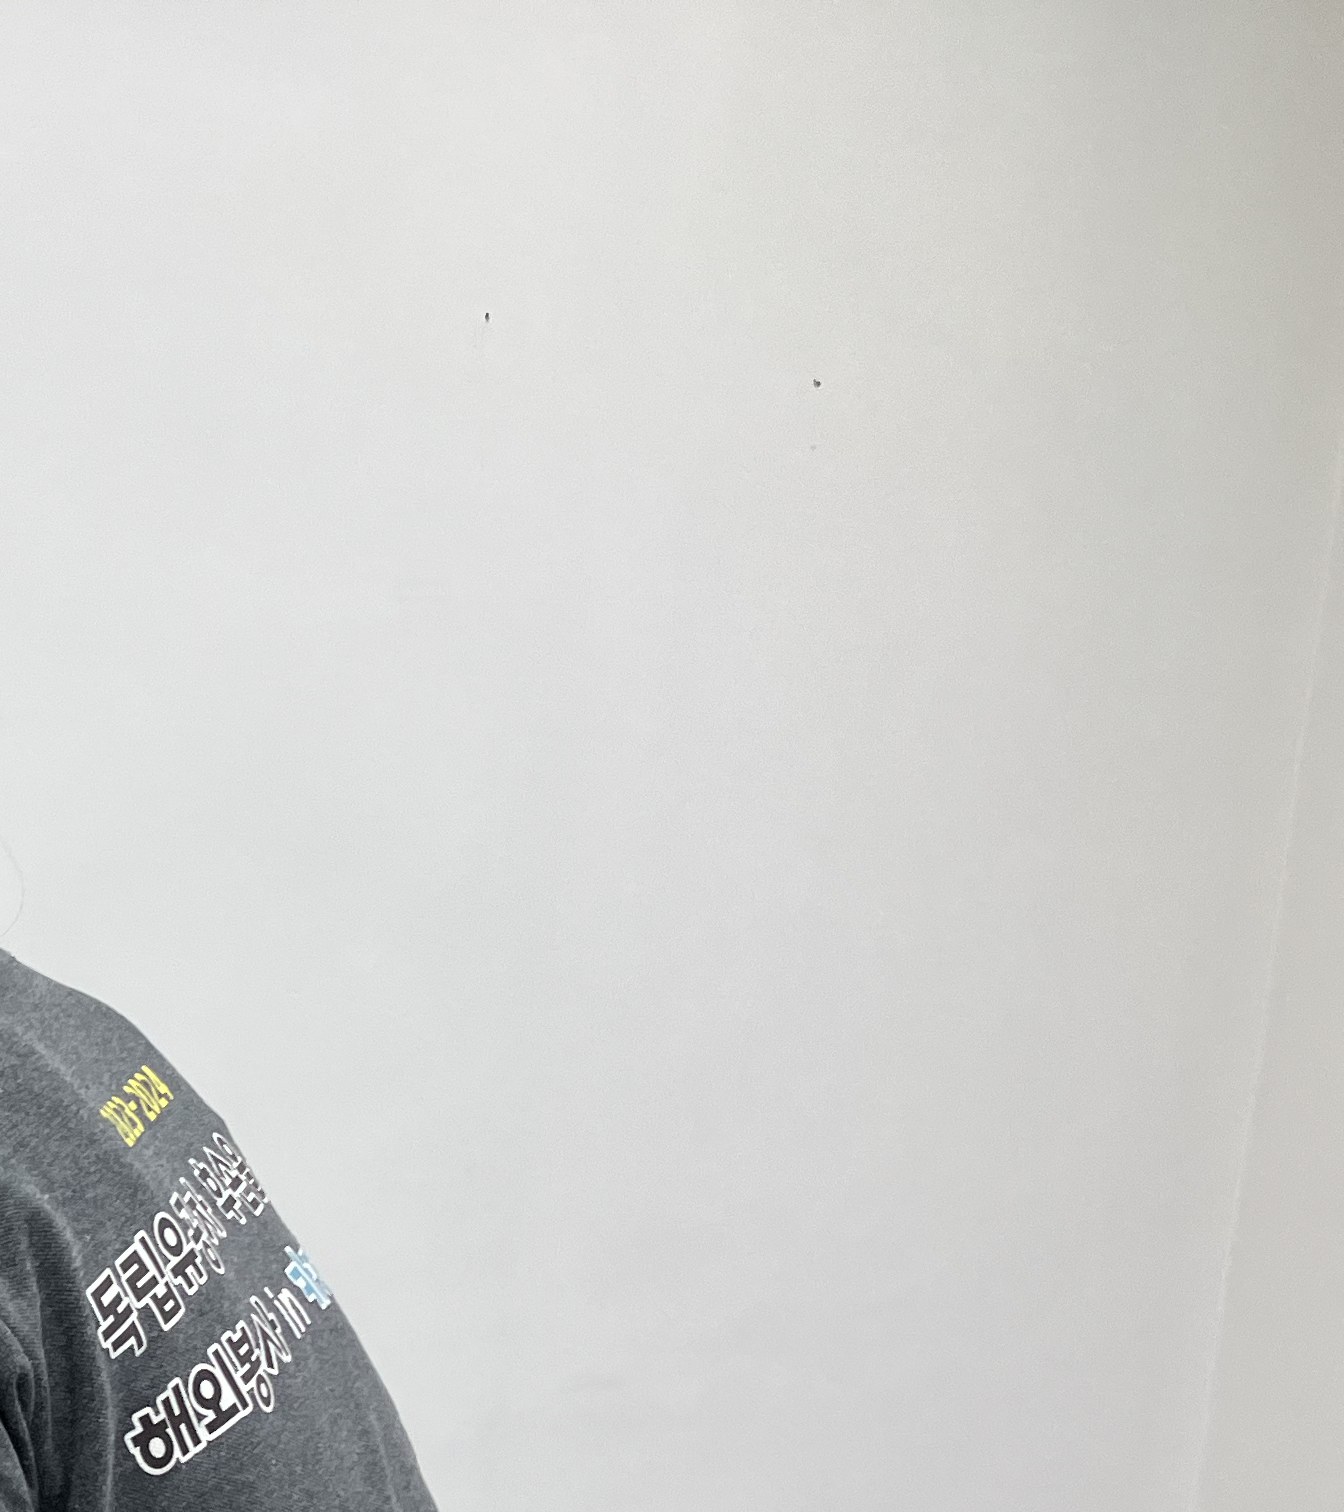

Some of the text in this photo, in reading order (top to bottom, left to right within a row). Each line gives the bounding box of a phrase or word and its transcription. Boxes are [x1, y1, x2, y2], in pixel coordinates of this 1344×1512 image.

[86, 1177, 226, 1358] 독립유공자
[124, 1286, 312, 1476] 해외봉사 in
